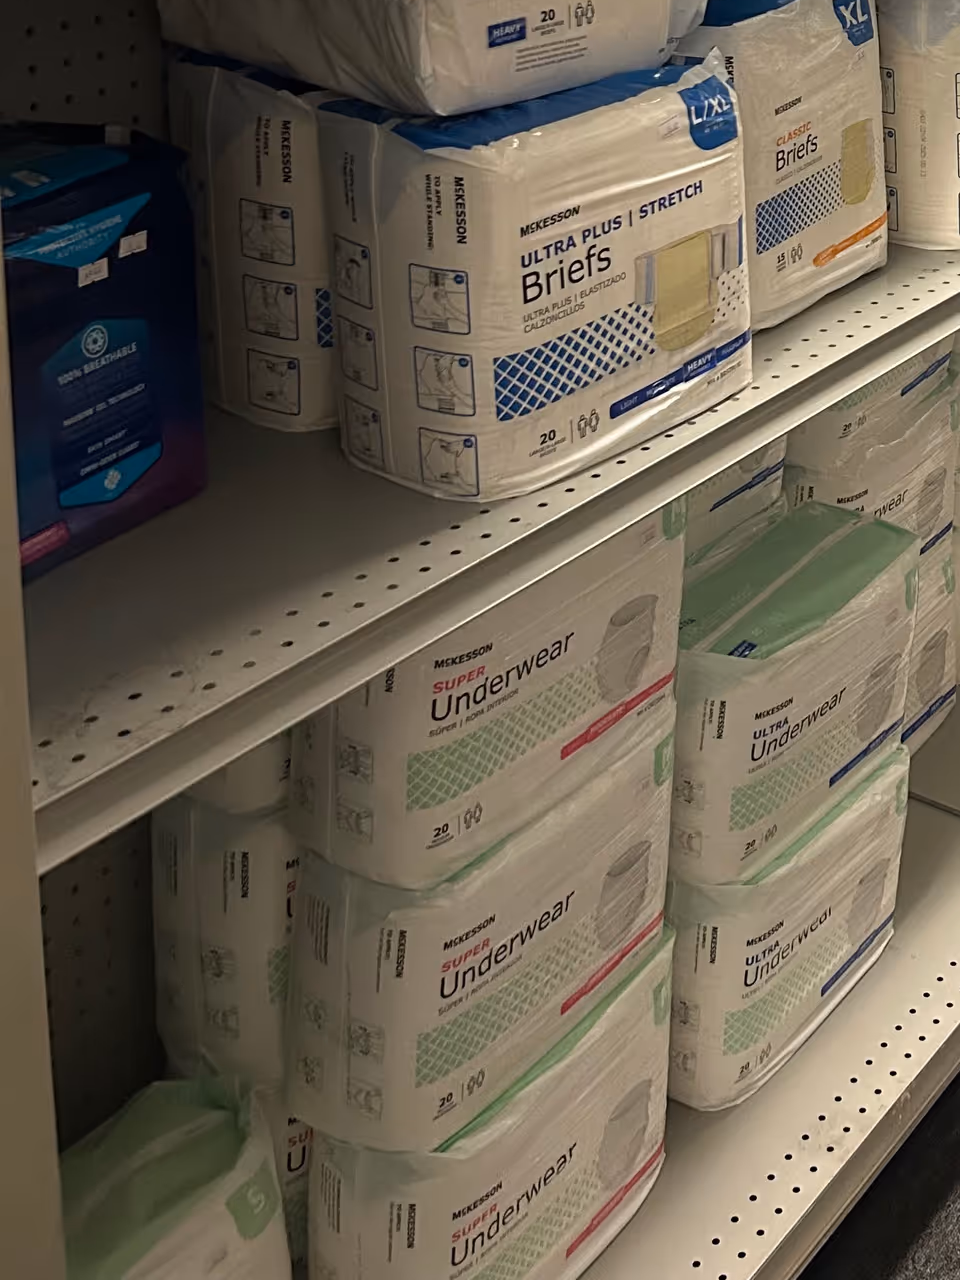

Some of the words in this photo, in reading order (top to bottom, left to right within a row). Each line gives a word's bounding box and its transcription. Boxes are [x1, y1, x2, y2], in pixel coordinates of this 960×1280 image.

[540, 8, 556, 23] 20
[839, 0, 869, 28] XL
[493, 23, 521, 37] HEAVY
[691, 94, 731, 125] L/XL
[776, 120, 812, 148] CLASSIC
[775, 133, 818, 173] Briefs
[520, 235, 577, 270] ULTRA
[581, 215, 623, 245] PLUS
[638, 179, 703, 221] STRETCH
[776, 251, 786, 265] 15
[520, 244, 612, 305] Briefs
[523, 302, 552, 325] ULTRA
[551, 293, 574, 315] PLUS
[524, 302, 586, 334] CALZONCILLOS
[84, 340, 138, 374] BREATHABLE
[687, 353, 713, 372] HEAVY
[539, 428, 557, 446] 20
[430, 631, 575, 722] Underwear
[431, 664, 486, 695] SUPER
[750, 686, 847, 762] Underwear
[752, 715, 789, 740] ULTRA
[432, 822, 449, 839] 20
[743, 838, 757, 851] 20
[439, 889, 575, 1000] Underwear
[440, 937, 490, 973] SUPER
[745, 939, 780, 967] ULTRA
[439, 1091, 454, 1108] 20
[450, 1140, 578, 1267] Underwear
[451, 1202, 498, 1244] SUPER
